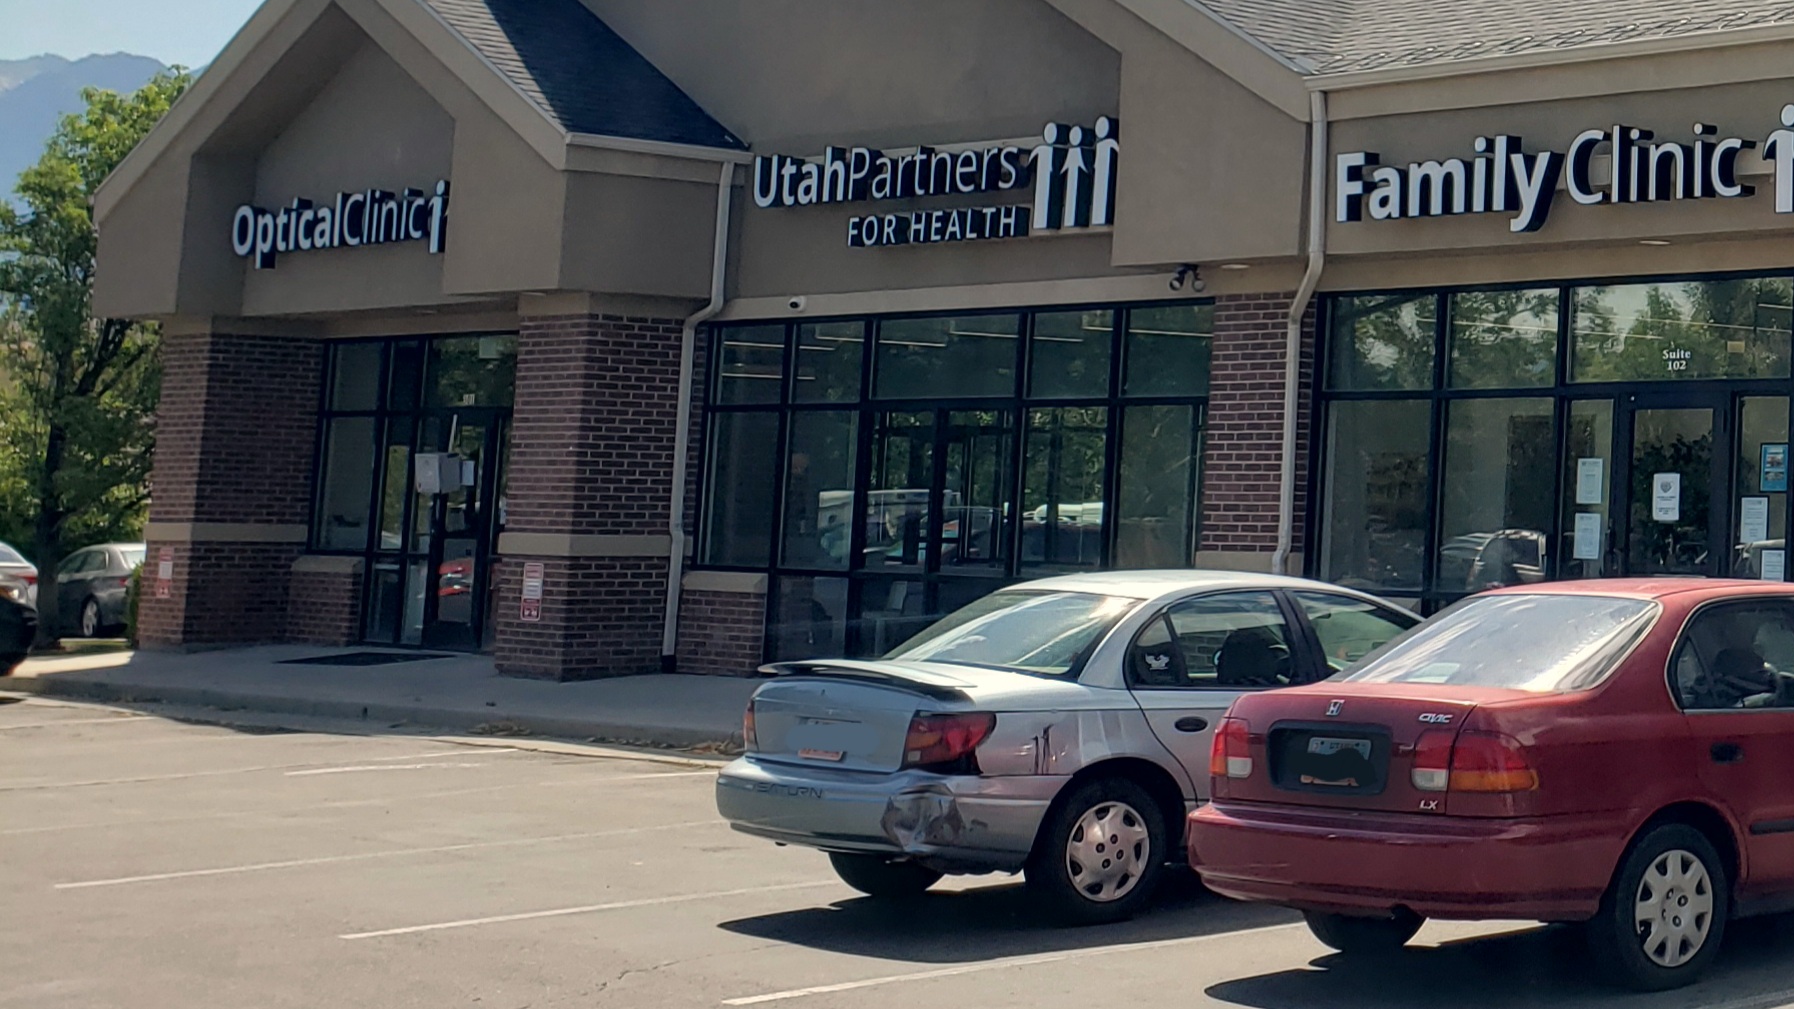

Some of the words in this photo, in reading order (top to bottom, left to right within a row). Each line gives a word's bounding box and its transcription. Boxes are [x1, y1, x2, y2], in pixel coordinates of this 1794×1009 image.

[848, 215, 897, 247] FOR
[910, 205, 1016, 243] HEALTH
[1662, 348, 1691, 360] Suite
[1667, 360, 1687, 371] 102
[1418, 712, 1454, 723] CIVIC
[755, 781, 823, 799] SATURN
[1419, 799, 1438, 810] LX
